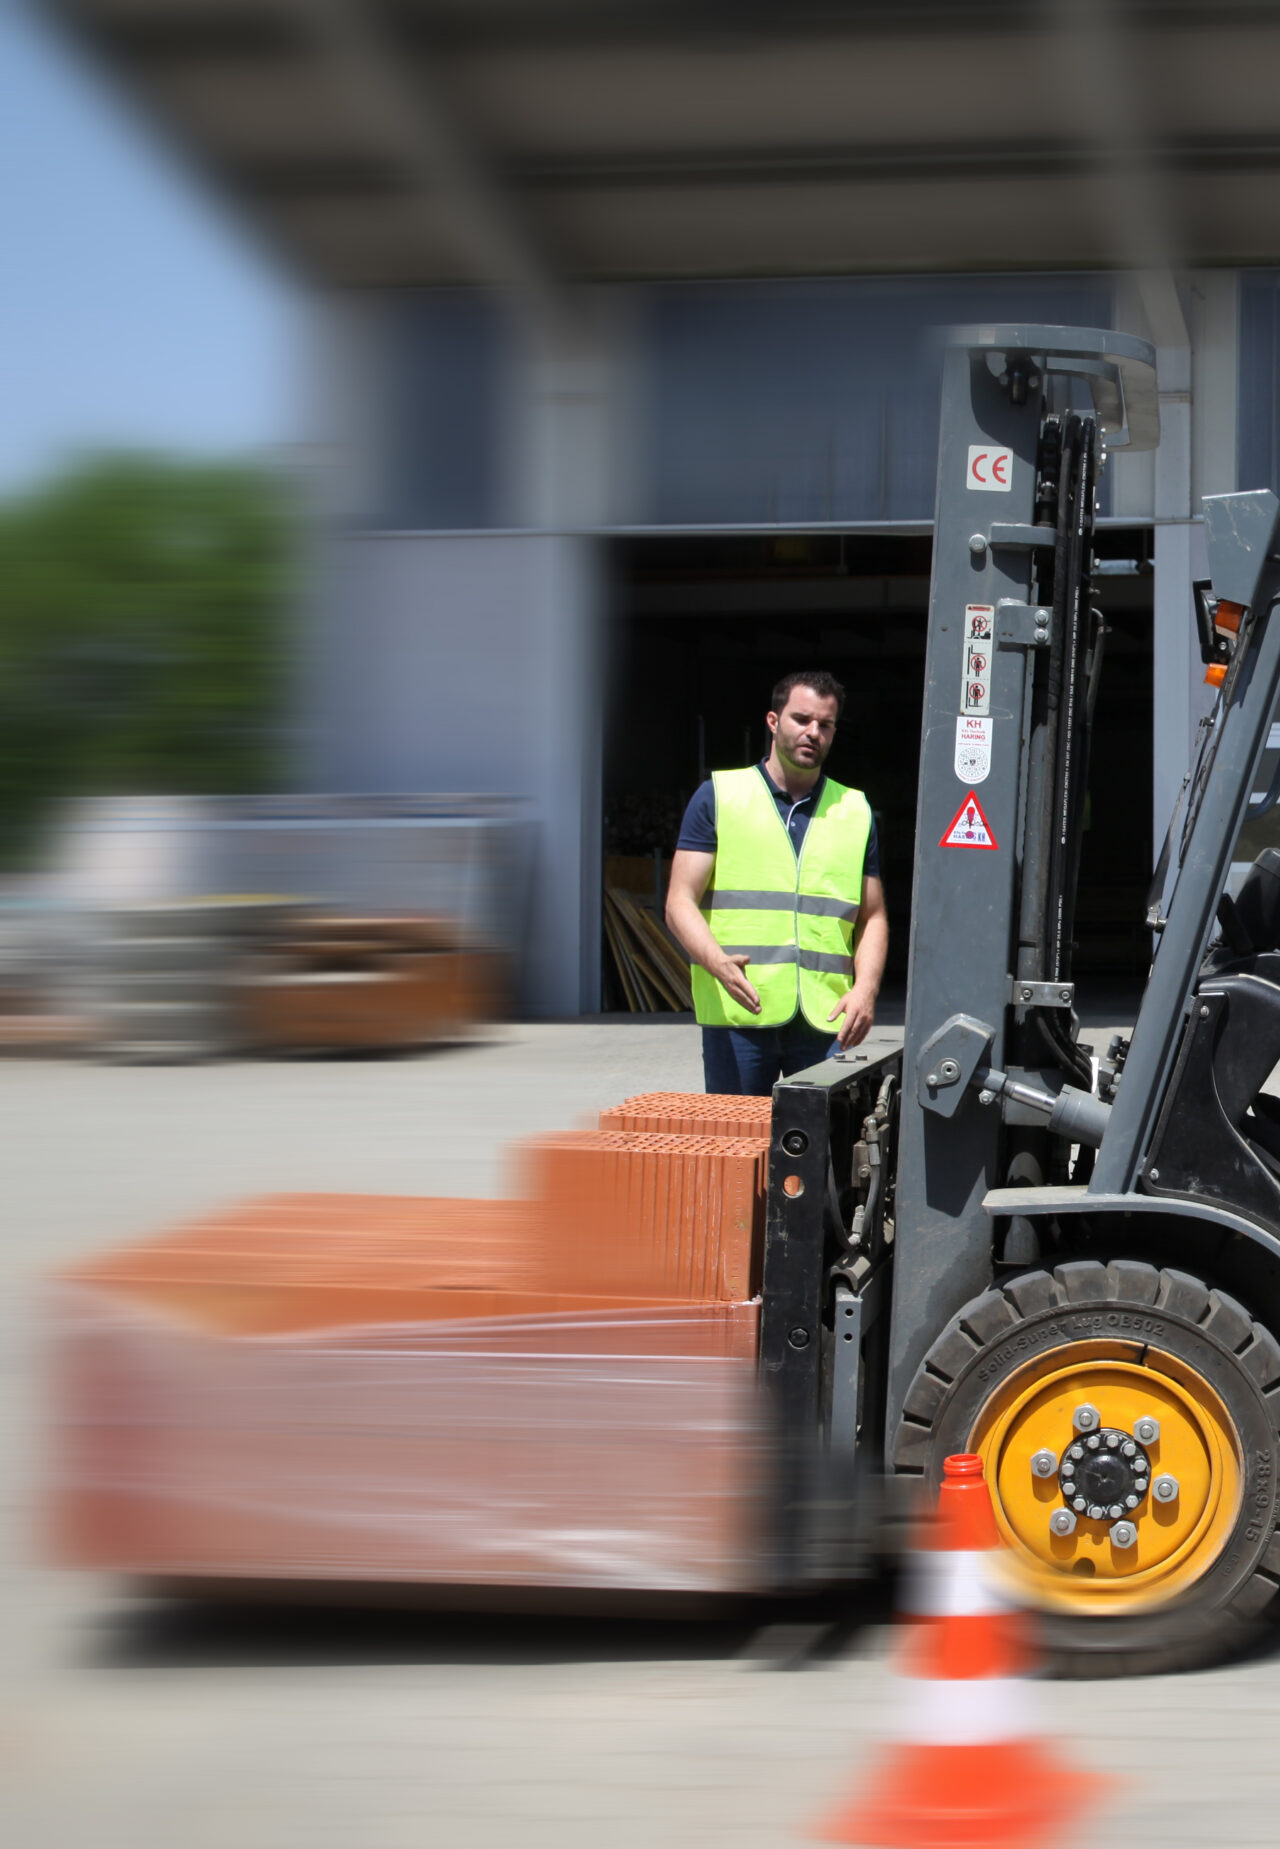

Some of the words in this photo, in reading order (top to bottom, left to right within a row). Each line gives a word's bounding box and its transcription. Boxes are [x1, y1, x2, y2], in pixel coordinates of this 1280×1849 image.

[972, 453, 1008, 484] CE
[966, 720, 982, 728] KH
[1071, 1315, 1103, 1330] Lug
